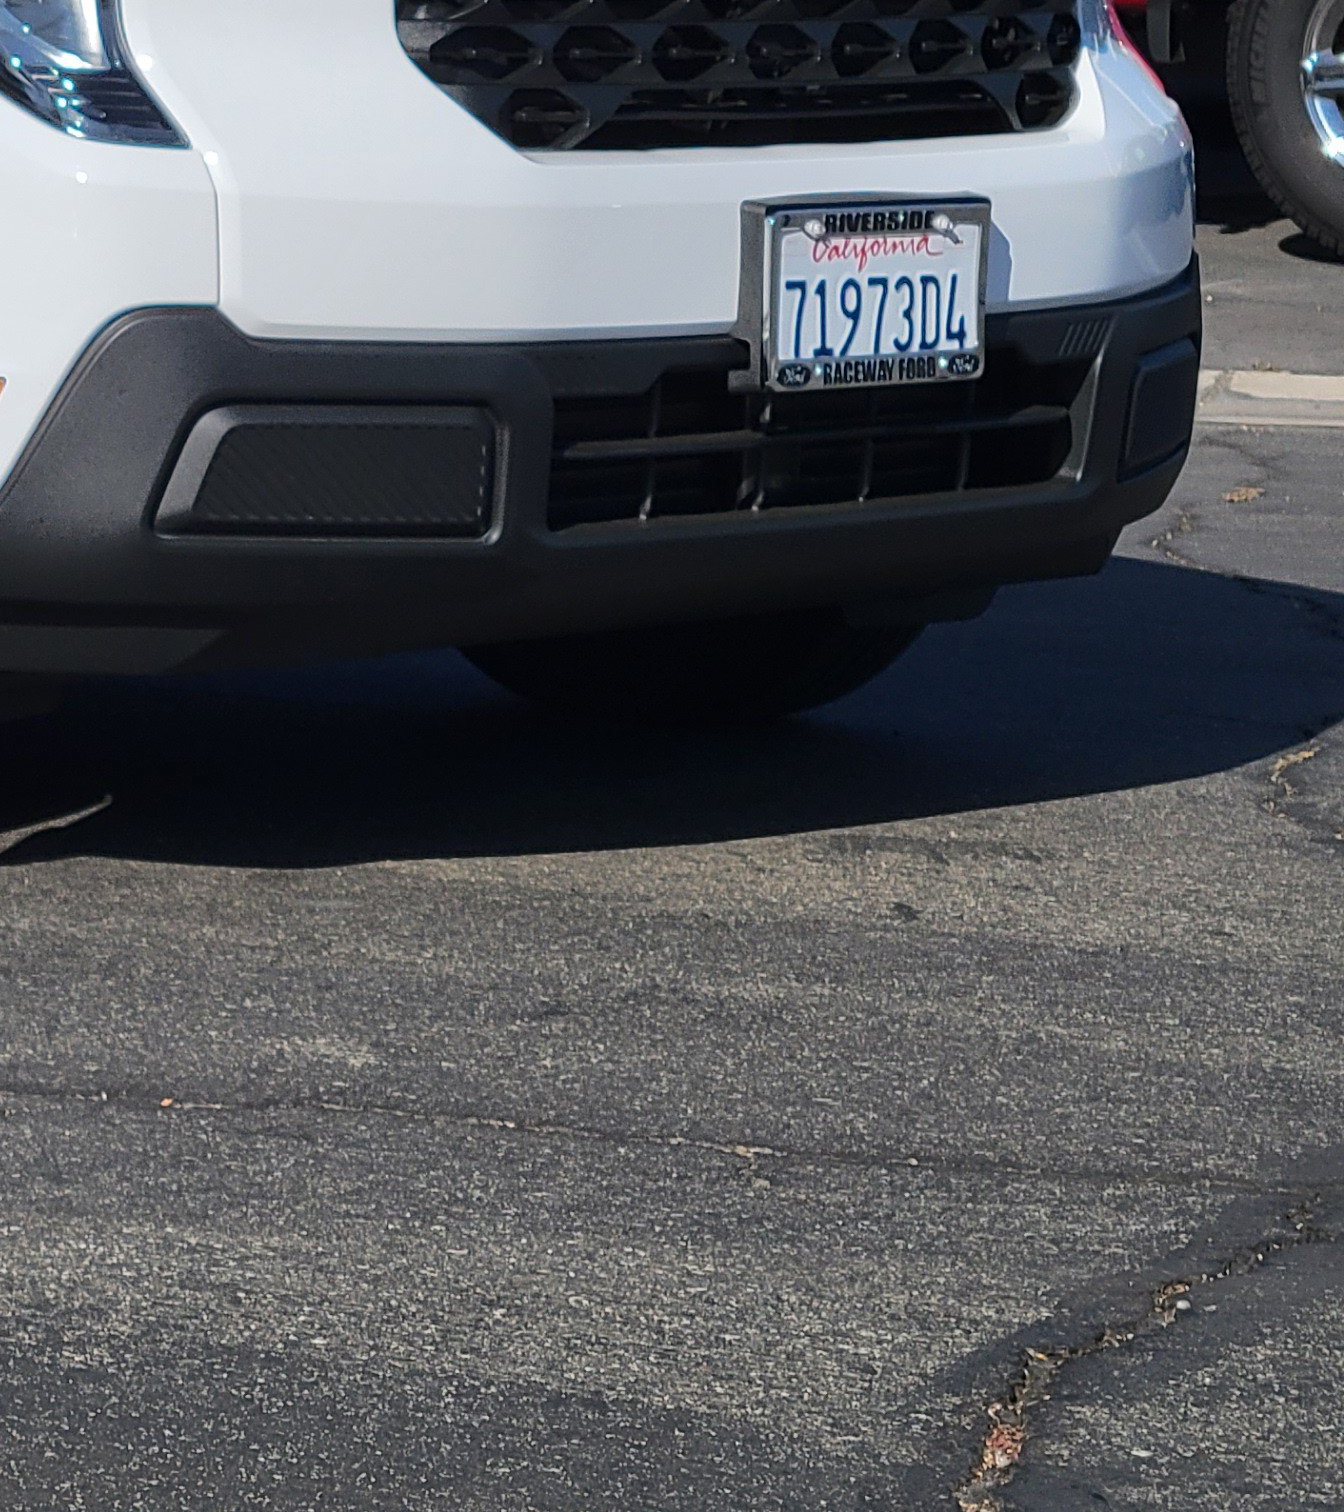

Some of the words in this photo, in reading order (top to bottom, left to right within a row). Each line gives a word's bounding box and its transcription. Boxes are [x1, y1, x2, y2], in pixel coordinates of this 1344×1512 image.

[813, 235, 944, 272] California
[785, 273, 967, 359] 71973D4
[823, 360, 895, 385] RACEWAY
[898, 357, 936, 377] FORD
